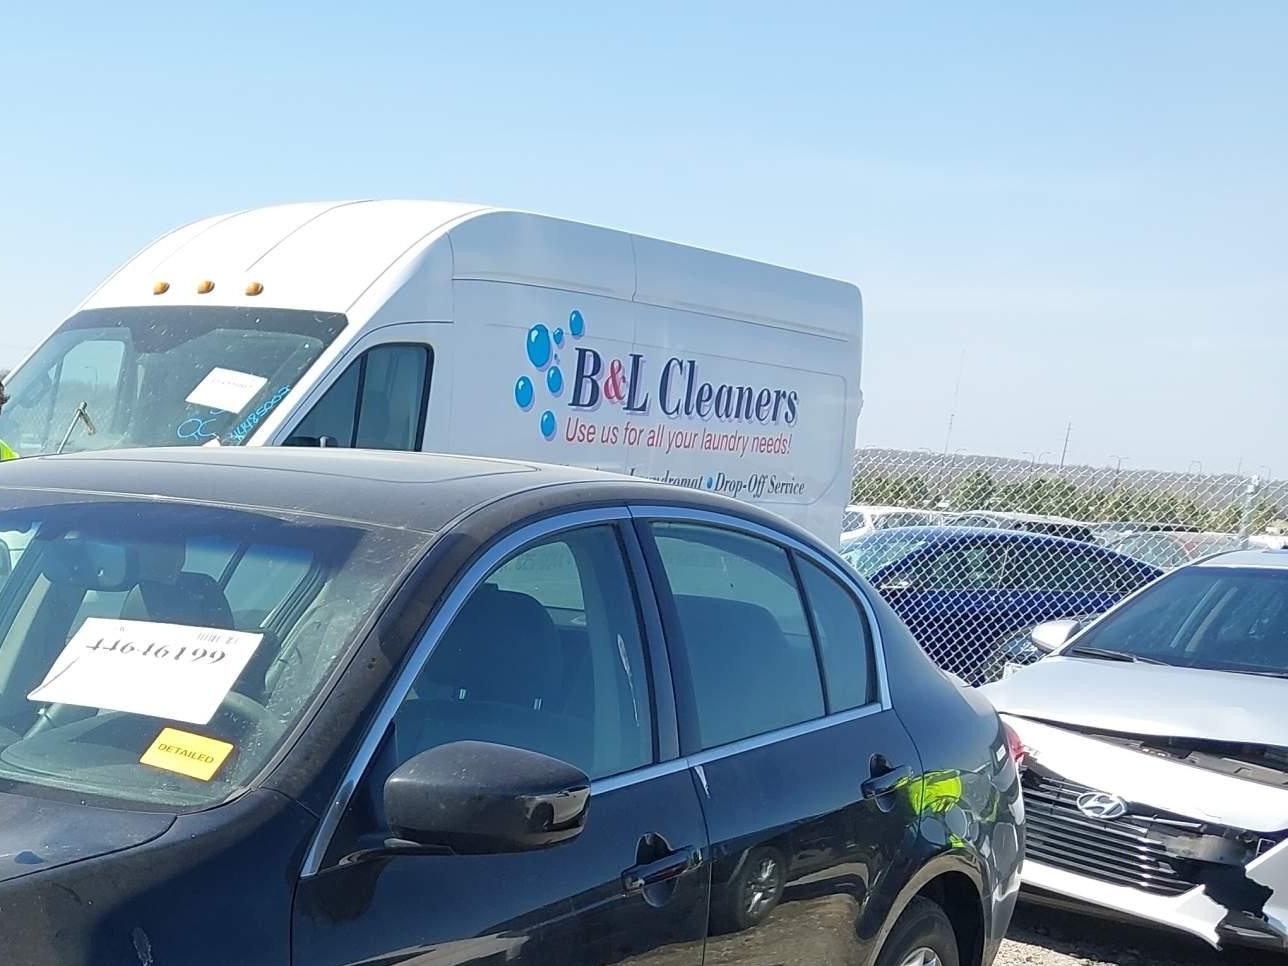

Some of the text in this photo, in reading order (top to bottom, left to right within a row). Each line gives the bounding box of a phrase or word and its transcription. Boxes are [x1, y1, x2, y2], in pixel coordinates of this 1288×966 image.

[568, 347, 799, 424] B&L Cleaners
[565, 416, 793, 458] Use us for all your laundry needs!
[714, 471, 769, 499] Drop-Off
[767, 474, 806, 496] Service
[86, 637, 226, 665] 44646199
[157, 742, 215, 765] DETAILED
